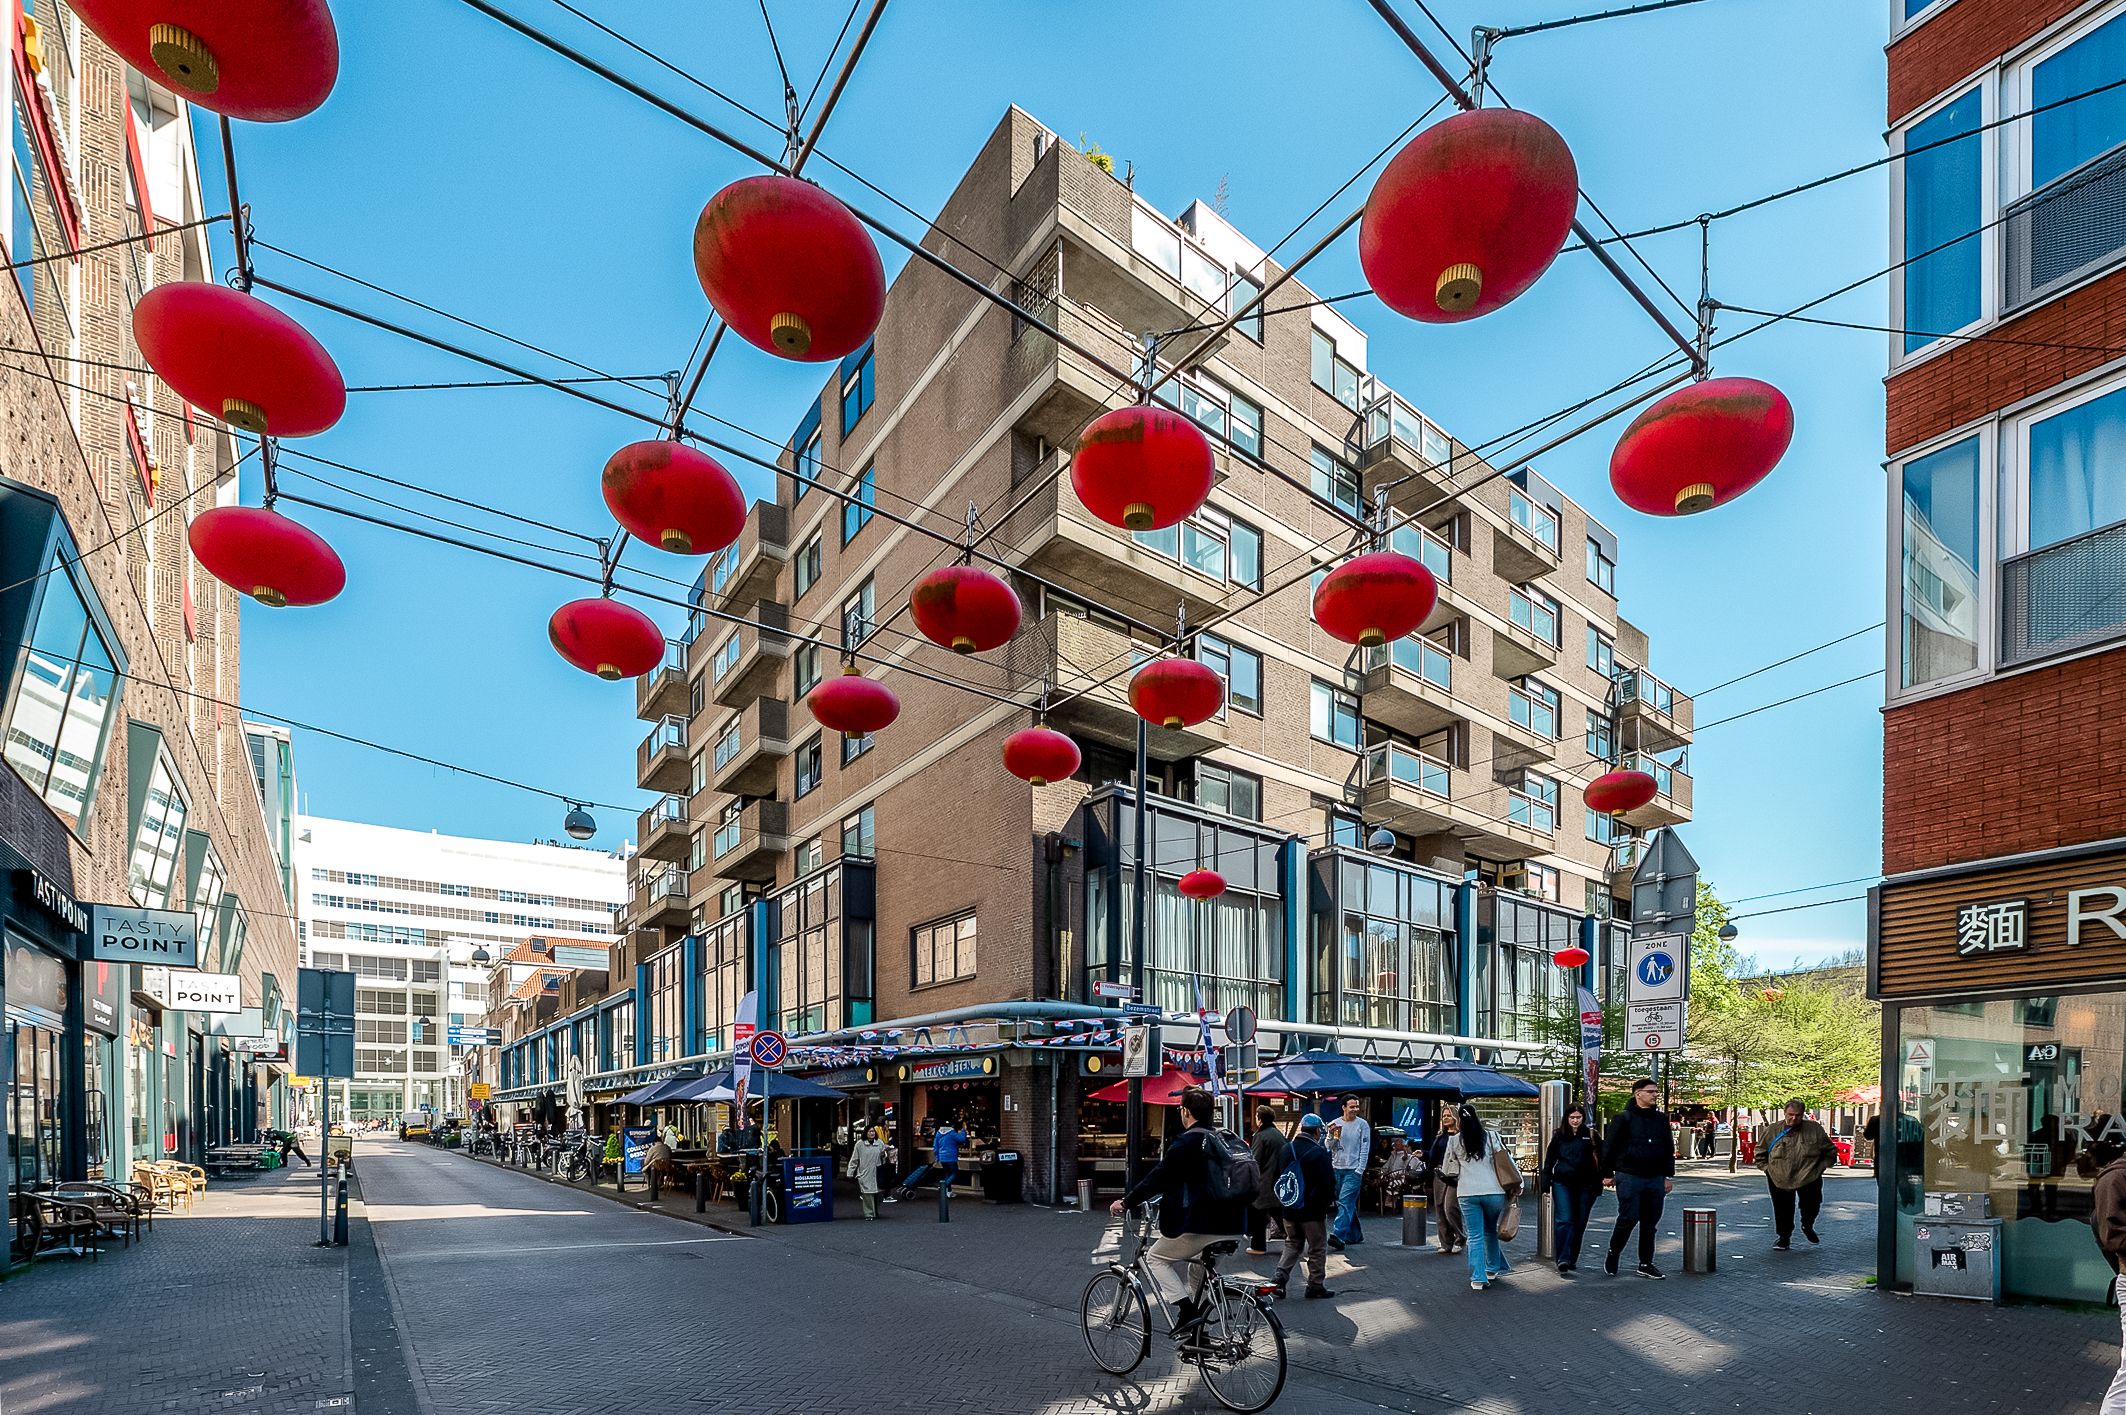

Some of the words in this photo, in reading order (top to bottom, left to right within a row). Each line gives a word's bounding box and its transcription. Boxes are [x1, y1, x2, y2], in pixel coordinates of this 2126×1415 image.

[2067, 886, 2126, 946] R
[102, 917, 185, 937] TASTY
[1958, 900, 2025, 955] 麵
[102, 935, 188, 954] POINT
[1645, 940, 1668, 950] ZONE
[177, 991, 235, 1004] POINT
[1126, 1005, 1161, 1014] Bezemstraat
[923, 1062, 949, 1077] LEKKER
[1928, 1070, 2031, 1145] 麵
[1941, 1253, 1957, 1261] AIR
